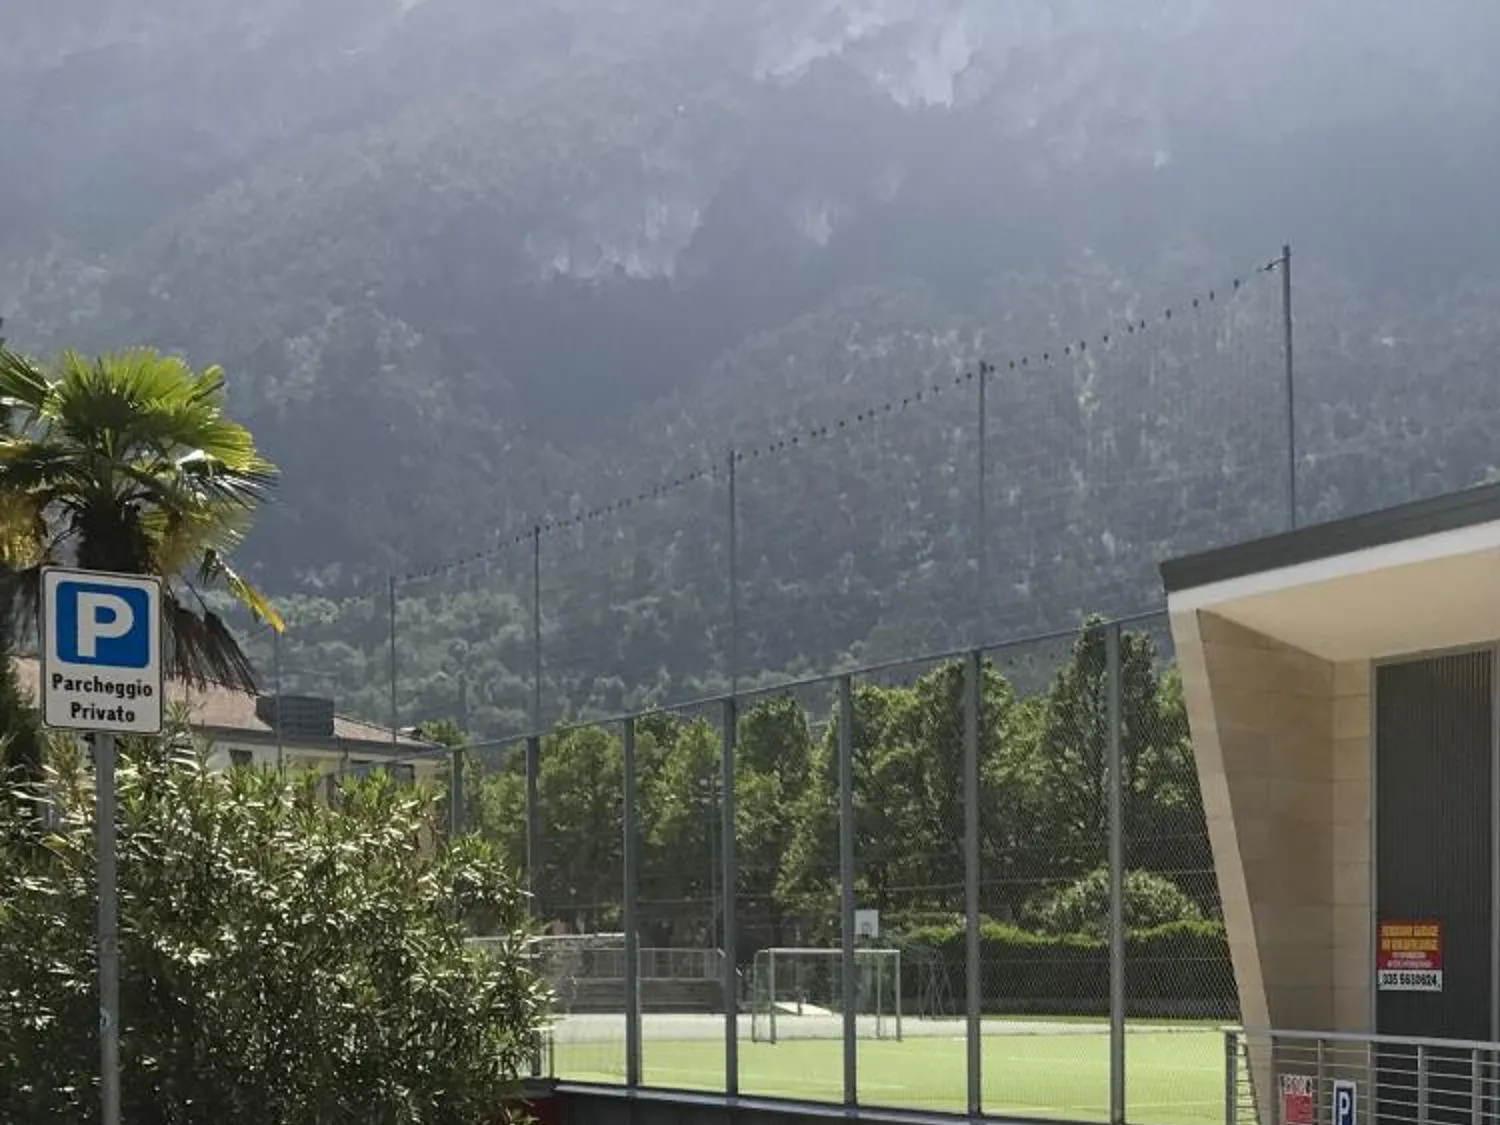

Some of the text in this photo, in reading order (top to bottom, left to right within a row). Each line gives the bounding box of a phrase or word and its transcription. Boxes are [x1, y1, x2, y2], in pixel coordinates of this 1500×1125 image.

[76, 591, 134, 657] P
[52, 673, 153, 699] Parcheggio
[70, 702, 135, 723] Privato
